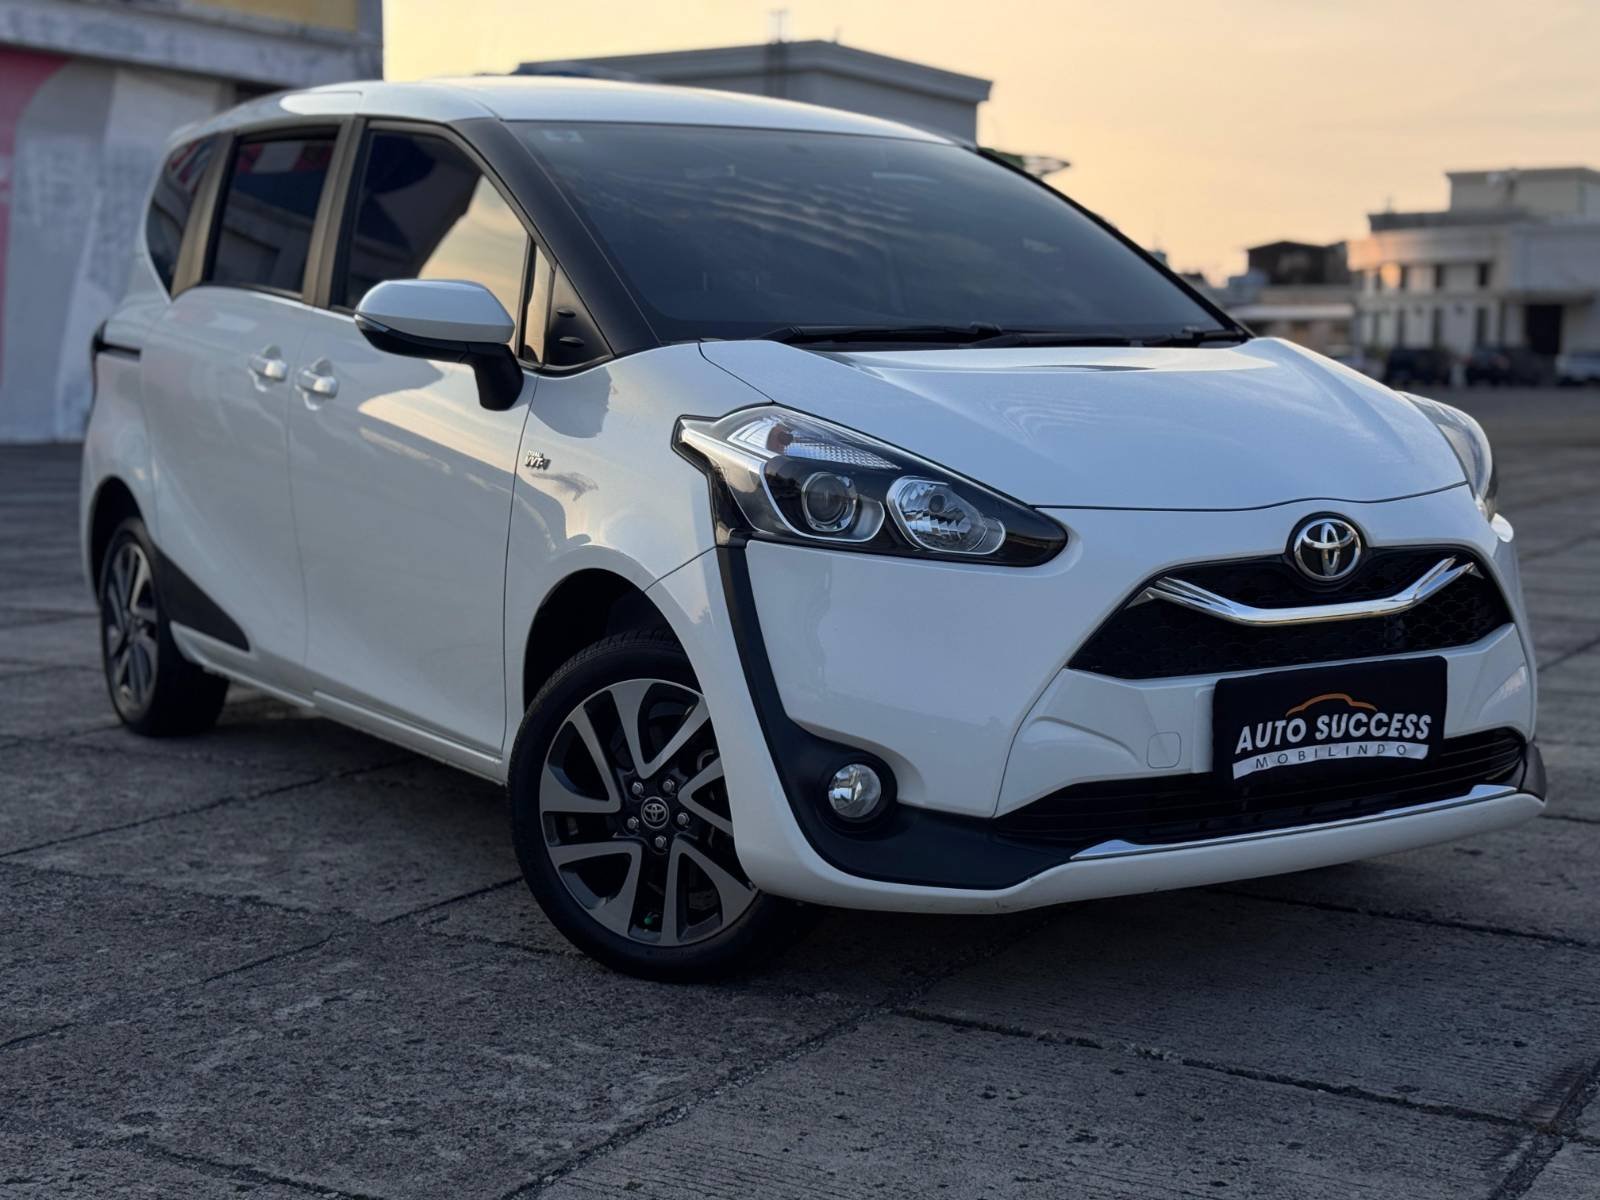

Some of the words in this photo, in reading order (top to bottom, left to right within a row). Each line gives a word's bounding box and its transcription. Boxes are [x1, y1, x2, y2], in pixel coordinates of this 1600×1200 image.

[1235, 718, 1306, 754] AUTO
[1315, 713, 1432, 740] SUCCESS
[1255, 744, 1407, 769] MOBILINDO
